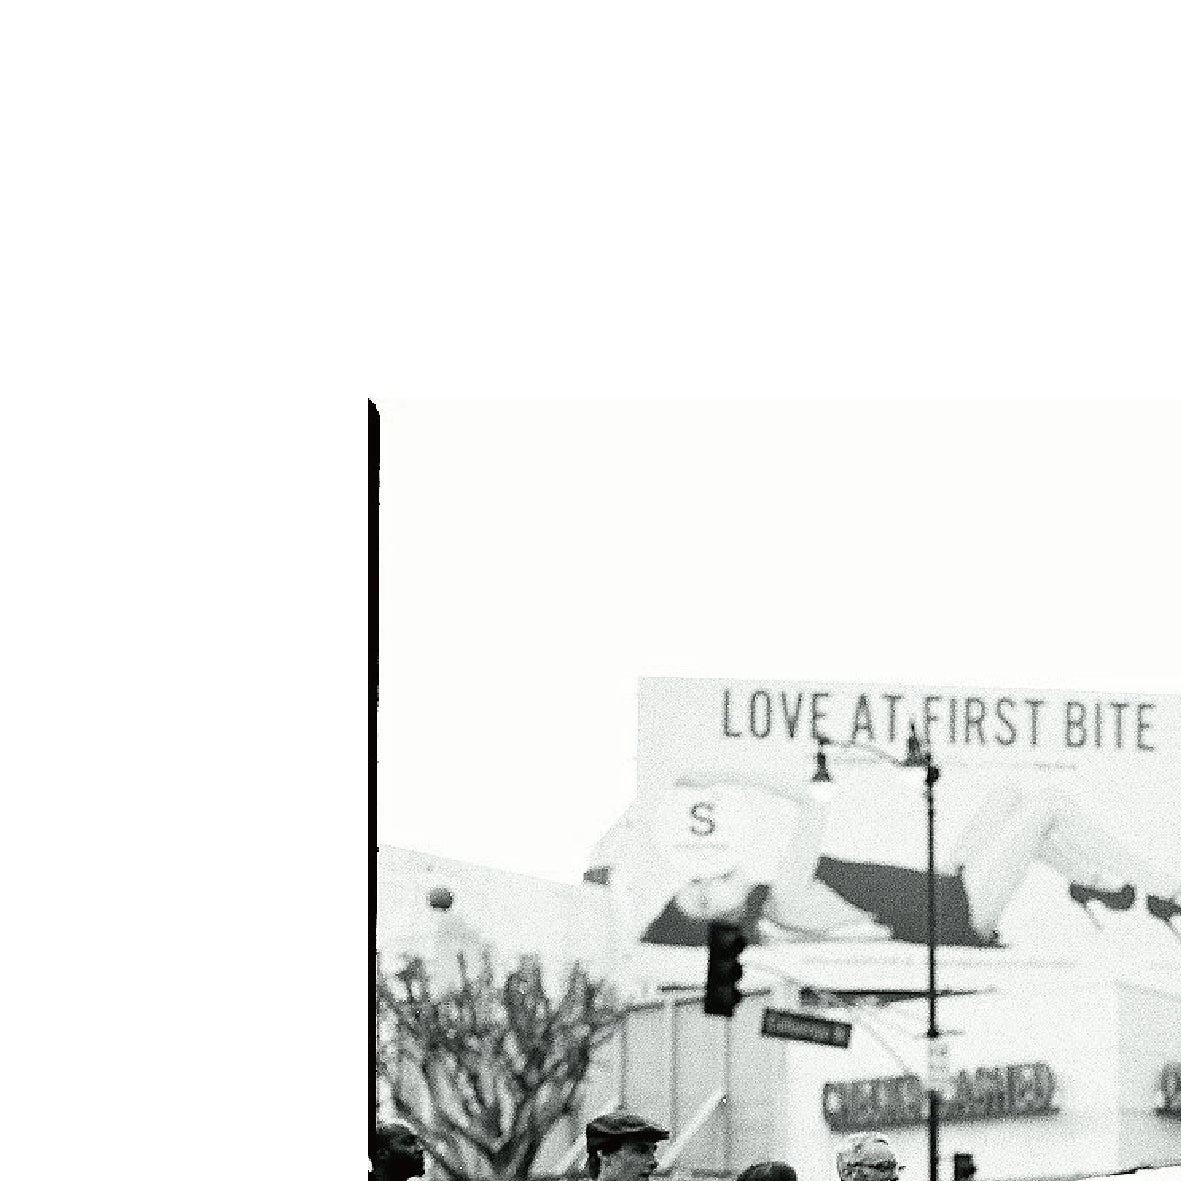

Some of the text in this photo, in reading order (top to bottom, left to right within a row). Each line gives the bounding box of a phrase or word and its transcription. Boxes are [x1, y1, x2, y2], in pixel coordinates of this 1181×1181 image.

[722, 688, 1157, 752] LOVE AT FIRST BITE
[689, 801, 716, 837] S
